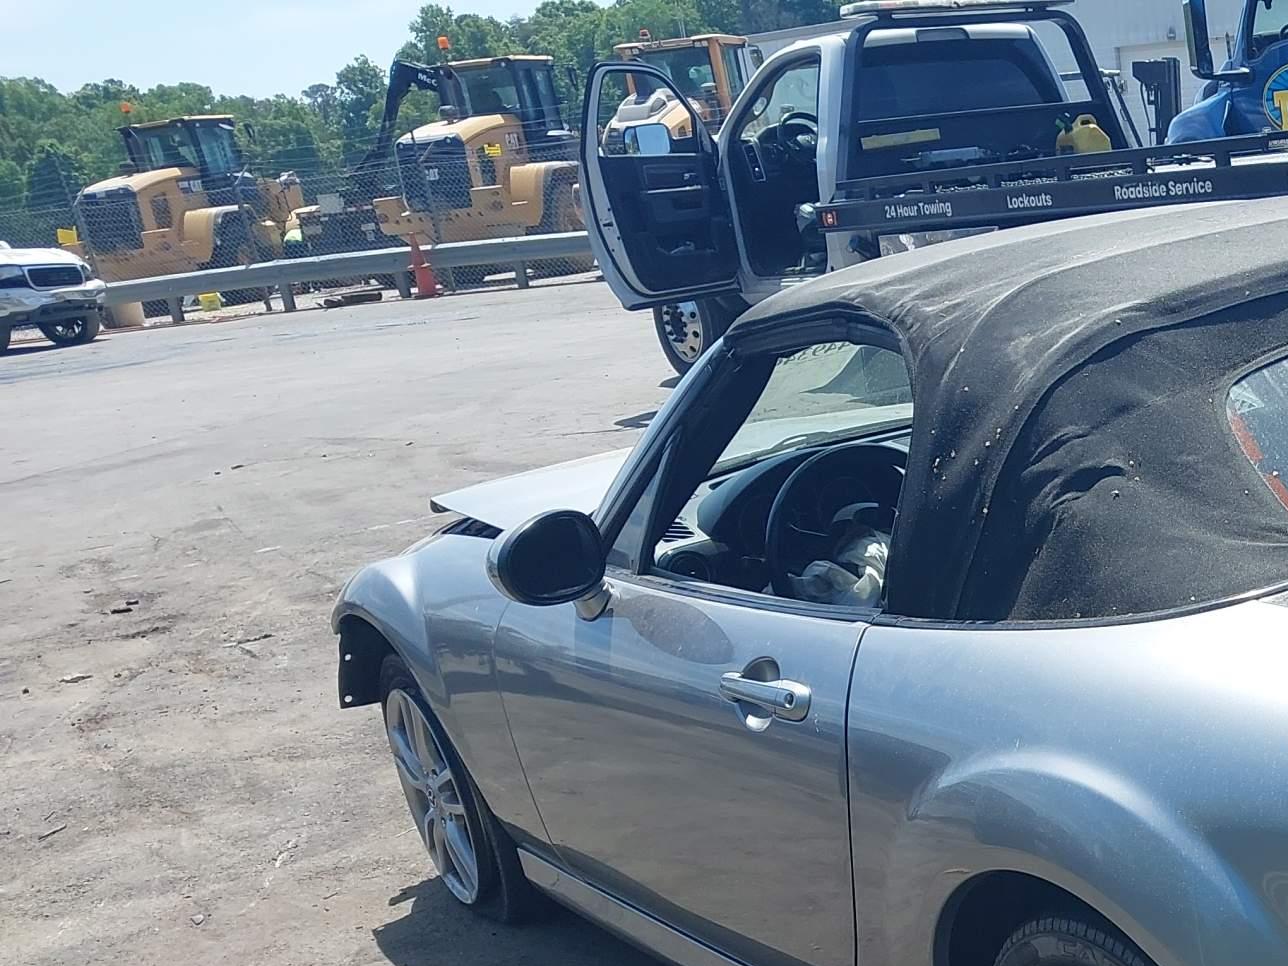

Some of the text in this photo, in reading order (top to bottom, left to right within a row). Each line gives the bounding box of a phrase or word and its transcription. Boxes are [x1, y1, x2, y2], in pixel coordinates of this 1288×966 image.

[1114, 177, 1213, 201] Roadside Service
[884, 199, 953, 219] 24 Hour Towing
[1006, 192, 1053, 209] Lockouts
